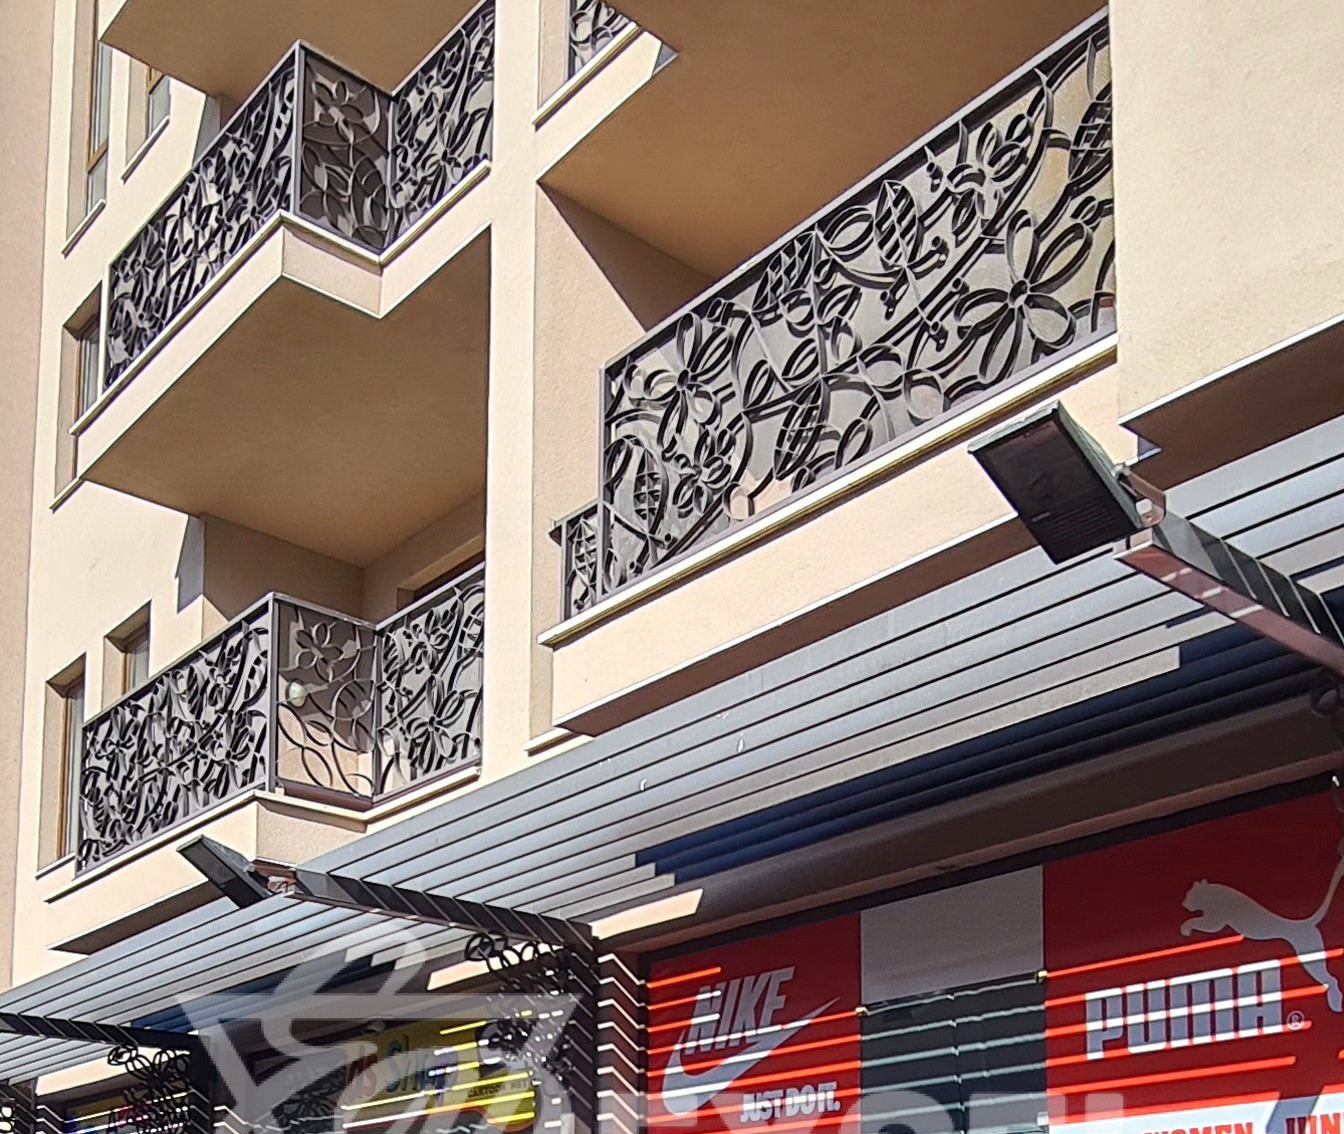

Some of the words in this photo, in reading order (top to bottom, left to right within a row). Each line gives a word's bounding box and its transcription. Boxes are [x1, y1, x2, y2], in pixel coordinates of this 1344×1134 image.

[683, 965, 795, 1056] NIKE
[1084, 958, 1284, 1062] PUMA
[739, 1088, 784, 1123] JUST
[785, 1084, 816, 1117] DO
